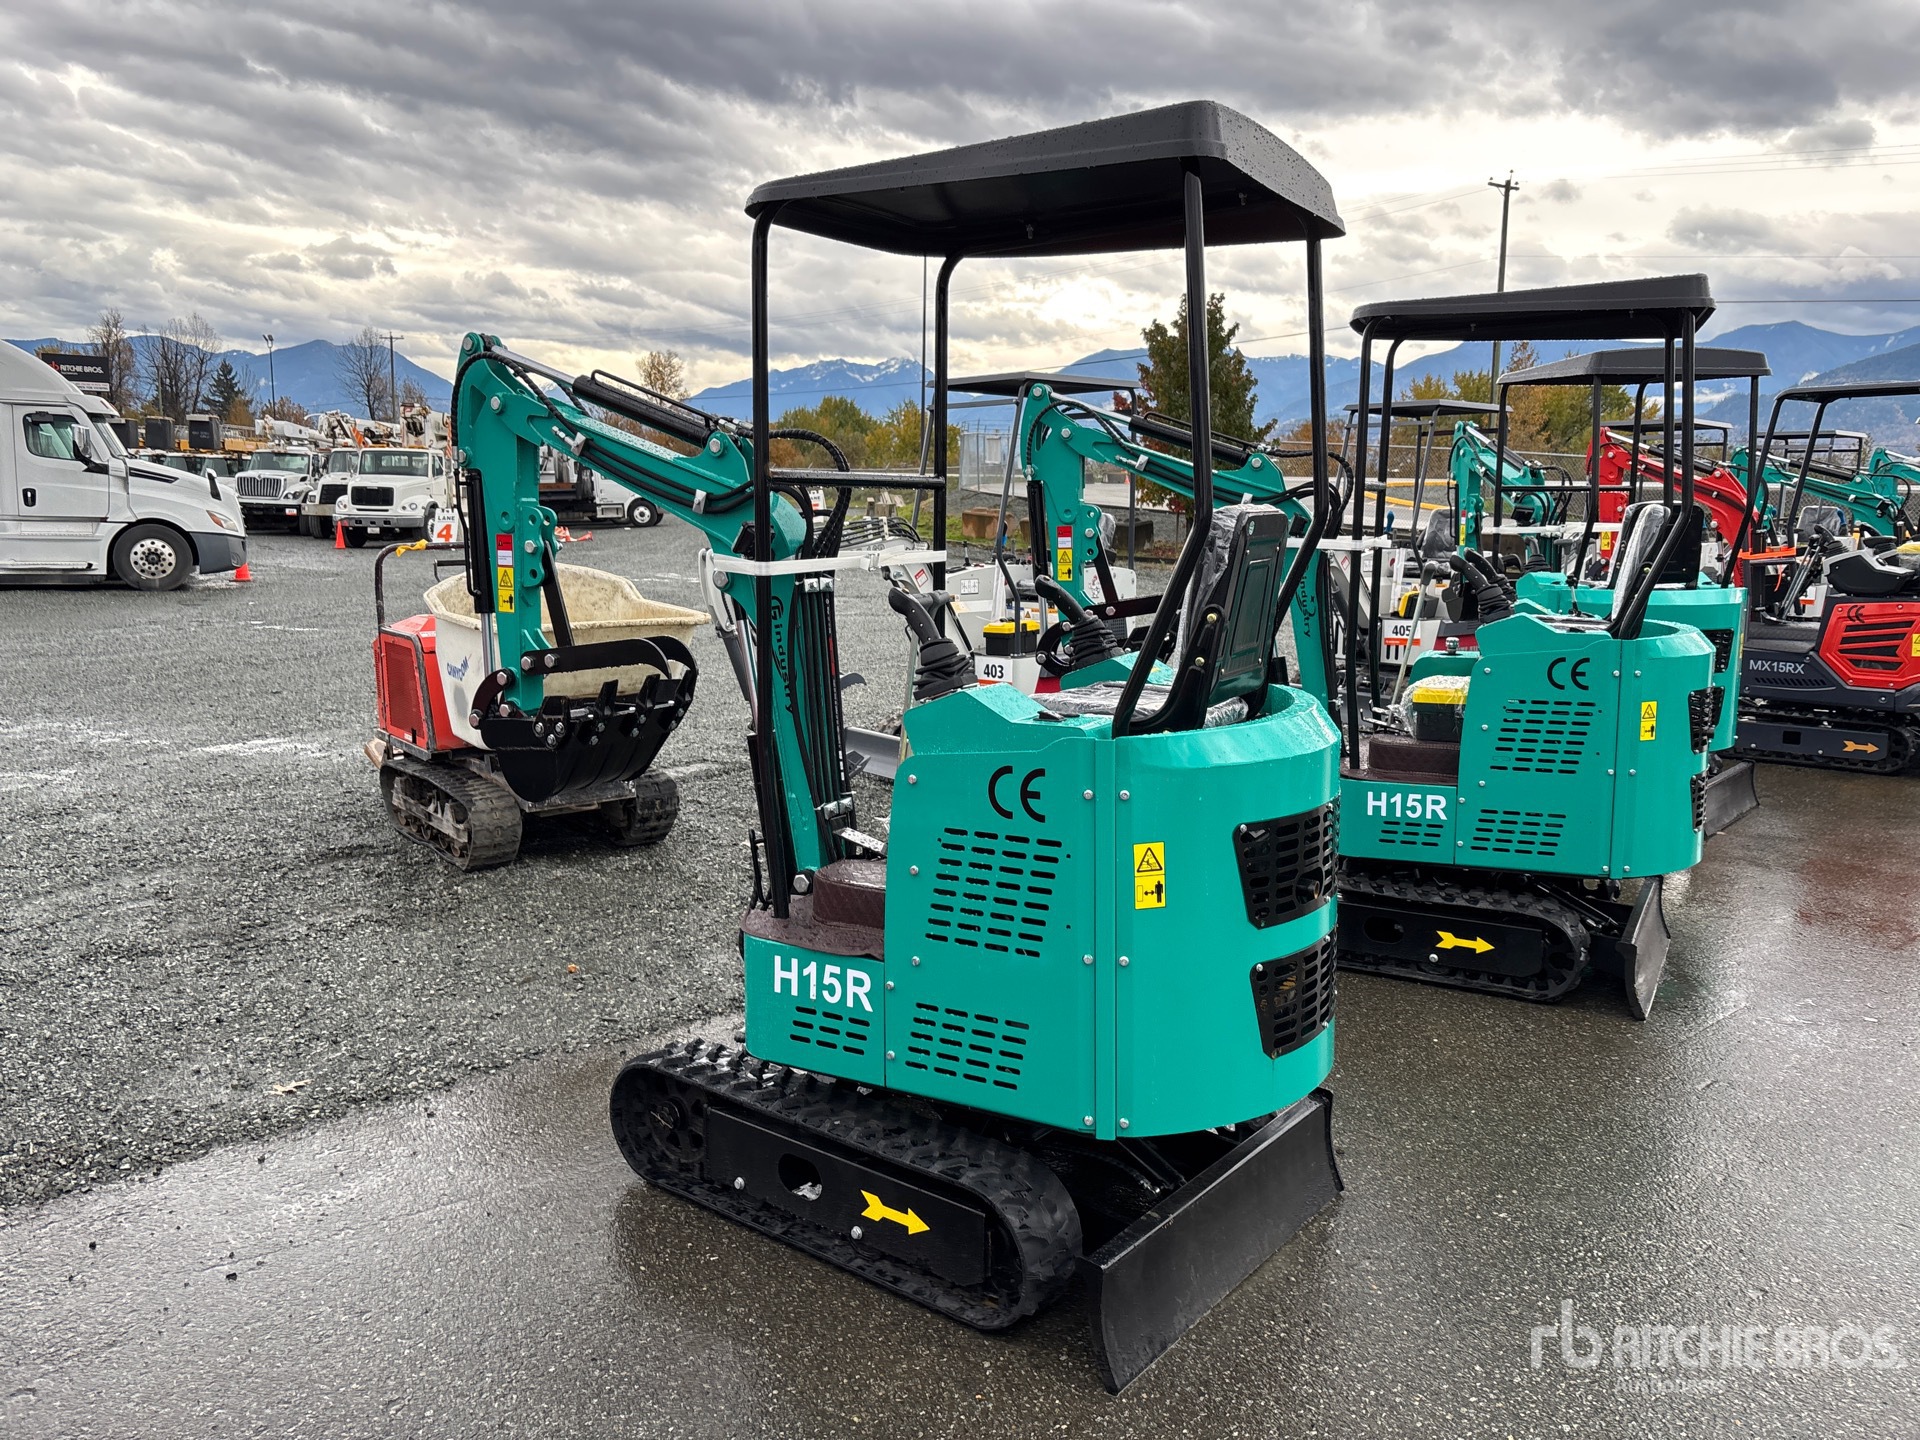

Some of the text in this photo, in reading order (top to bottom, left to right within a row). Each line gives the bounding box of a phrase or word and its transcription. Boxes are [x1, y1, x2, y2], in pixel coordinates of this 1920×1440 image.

[436, 523, 453, 542] 4
[983, 663, 1004, 679] 403
[1749, 659, 1805, 675] MX15RX
[1366, 791, 1448, 821] H15R
[773, 954, 874, 1013] H15R
